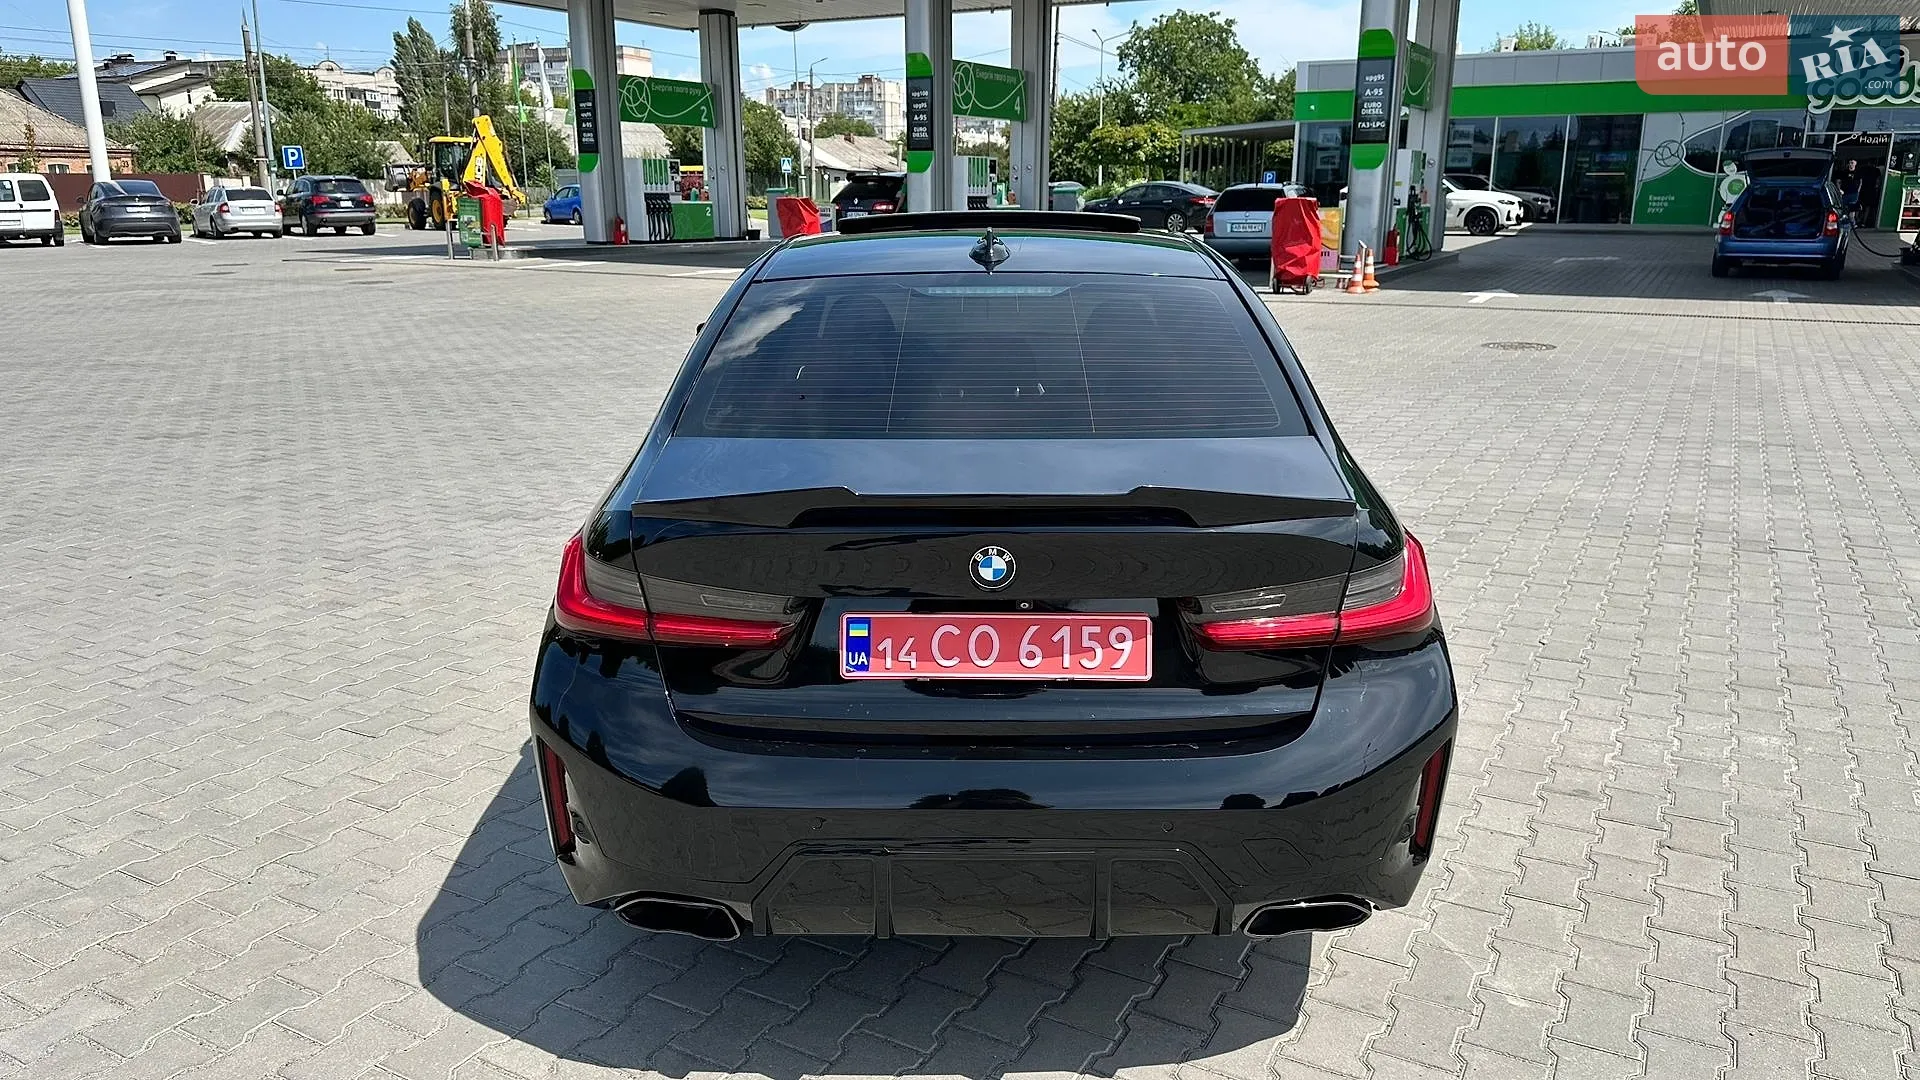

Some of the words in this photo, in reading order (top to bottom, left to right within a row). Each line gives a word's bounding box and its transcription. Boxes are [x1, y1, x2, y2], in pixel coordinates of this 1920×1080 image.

[1014, 95, 1021, 115] 4
[700, 106, 708, 122] 2
[288, 148, 299, 166] P
[1266, 172, 1274, 183] P
[705, 206, 711, 216] 2
[974, 548, 1012, 562] BMW
[877, 637, 917, 670] 14
[930, 624, 1000, 669] CO
[1018, 624, 1134, 670] 6159
[848, 651, 869, 666] UA
